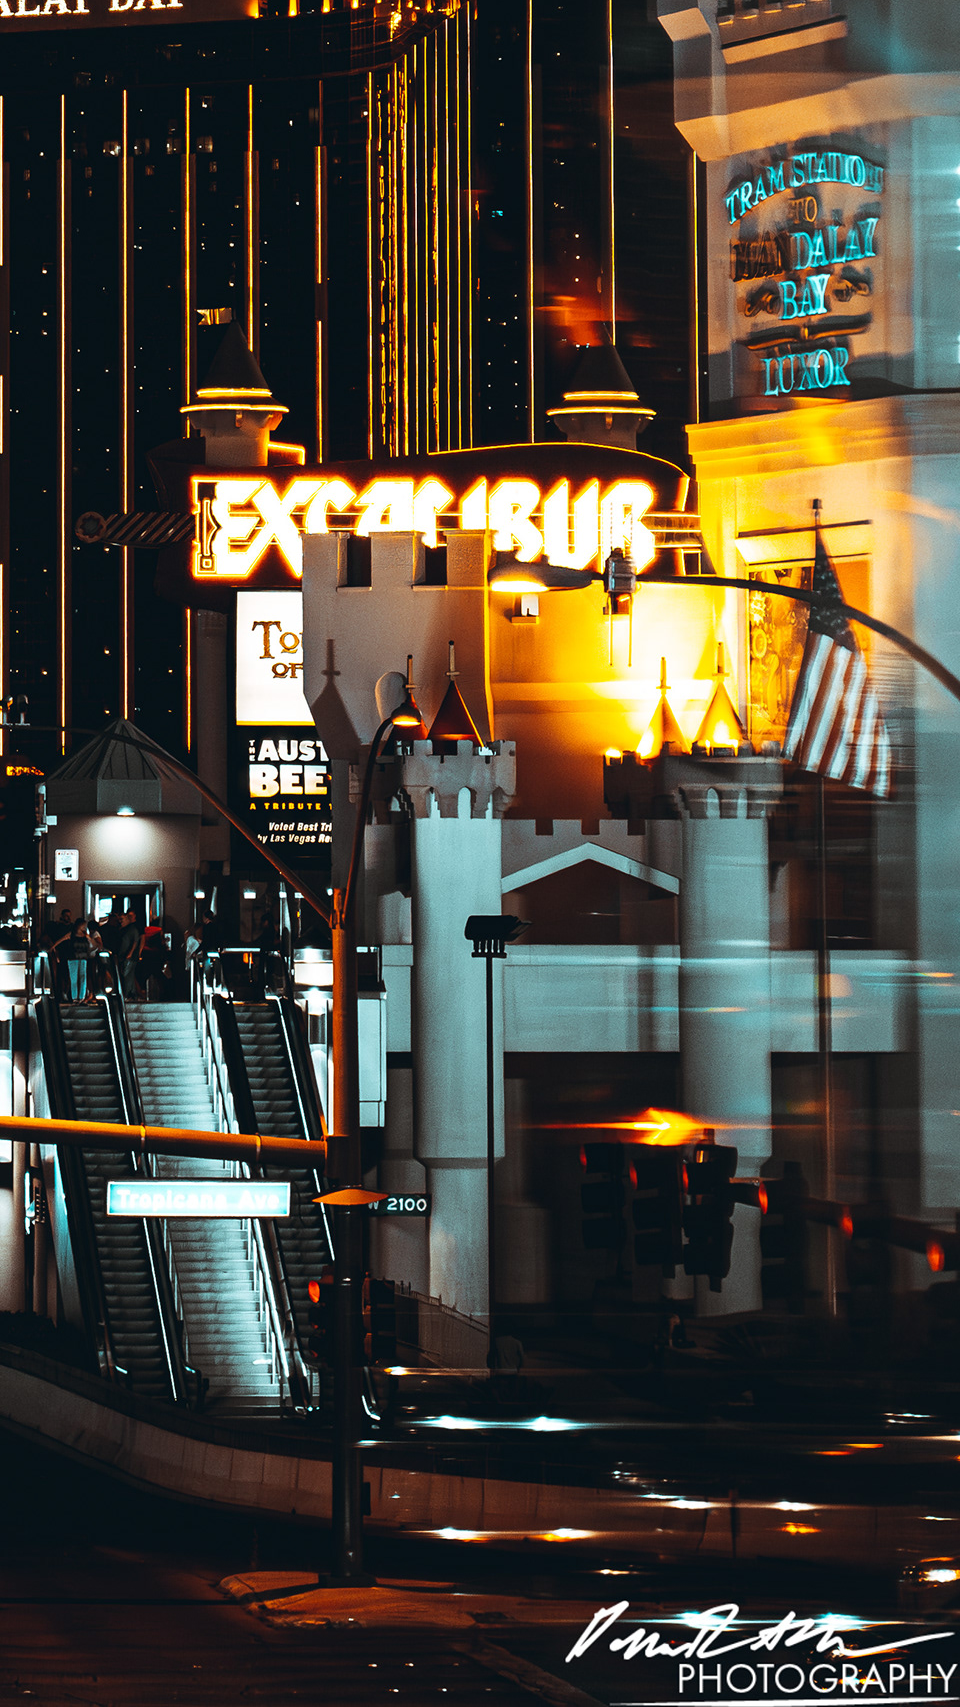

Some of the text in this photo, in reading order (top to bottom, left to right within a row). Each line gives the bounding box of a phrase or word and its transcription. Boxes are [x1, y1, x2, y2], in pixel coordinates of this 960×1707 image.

[726, 162, 786, 225] TRAM
[779, 274, 831, 320] BAY
[760, 347, 851, 396] LUXOR
[251, 620, 304, 659] TO
[249, 764, 328, 798] BEE
[249, 802, 257, 810] A
[264, 802, 322, 810] TRIBUTE
[268, 822, 295, 831] Voted
[297, 822, 319, 832] Best
[270, 834, 286, 843] Las
[288, 834, 316, 845] Vegas
[116, 1189, 280, 1211] Tropicana Ave
[386, 1197, 428, 1212] 2100
